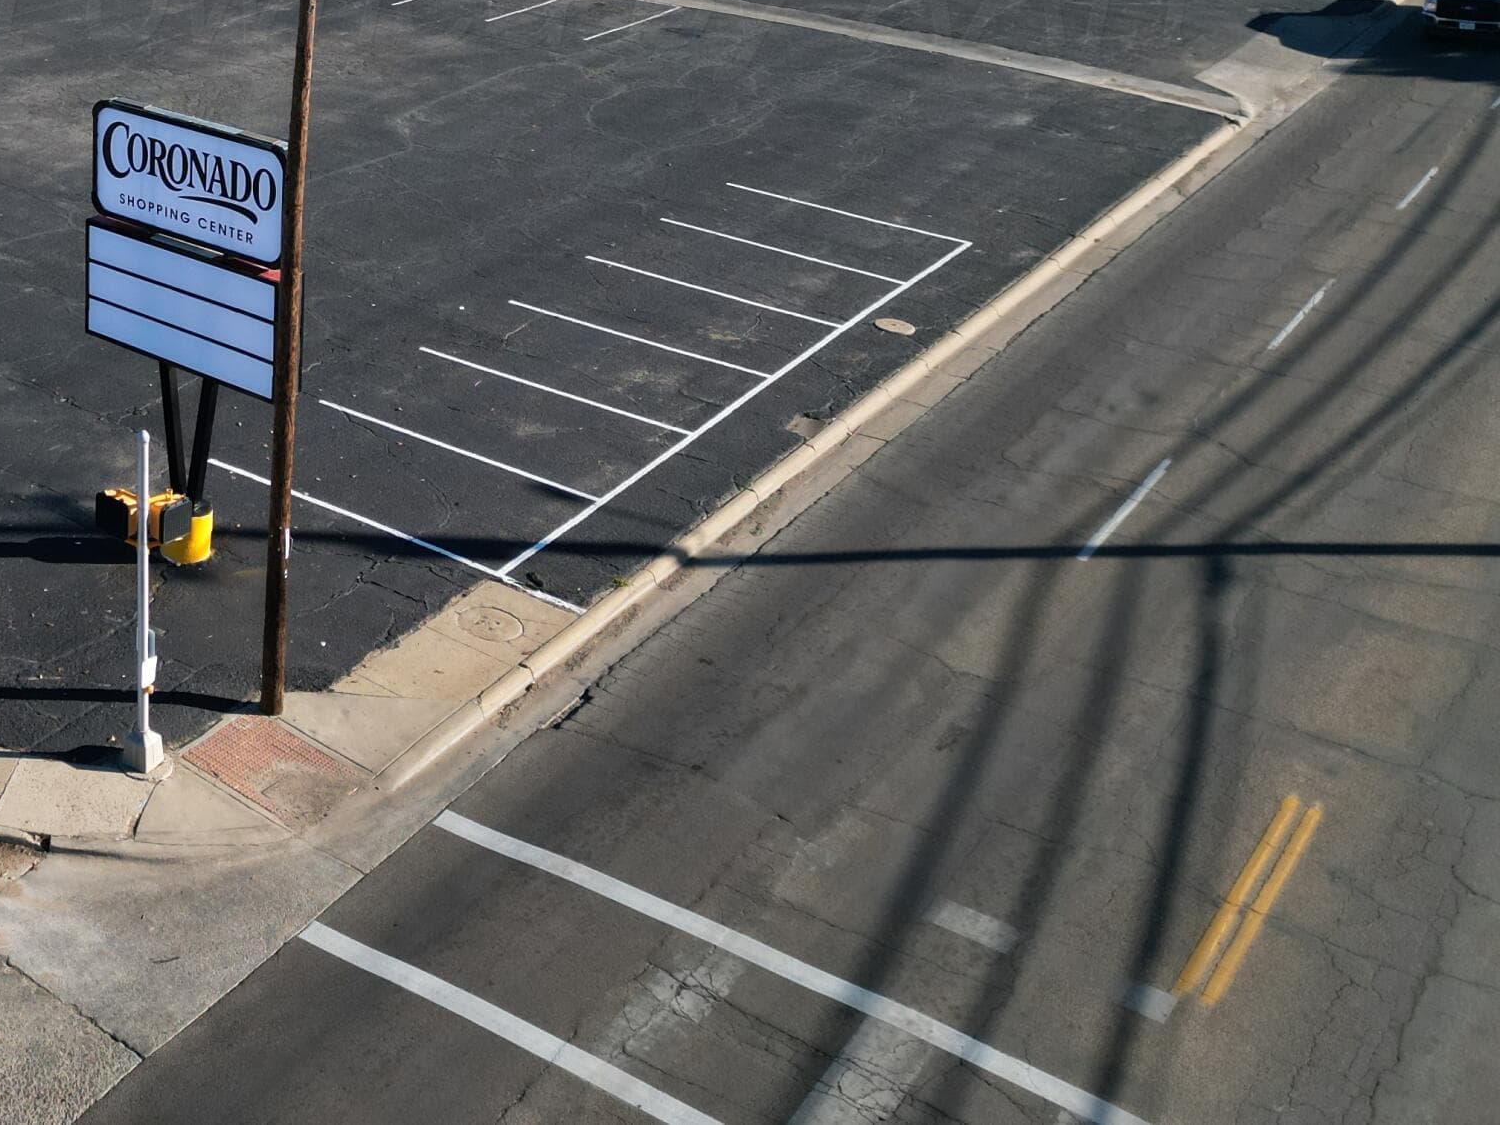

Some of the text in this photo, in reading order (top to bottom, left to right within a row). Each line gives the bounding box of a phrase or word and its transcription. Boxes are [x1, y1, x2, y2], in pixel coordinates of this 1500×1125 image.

[102, 121, 276, 212] CORONADO
[119, 193, 254, 245] SHOPPING CENTER
